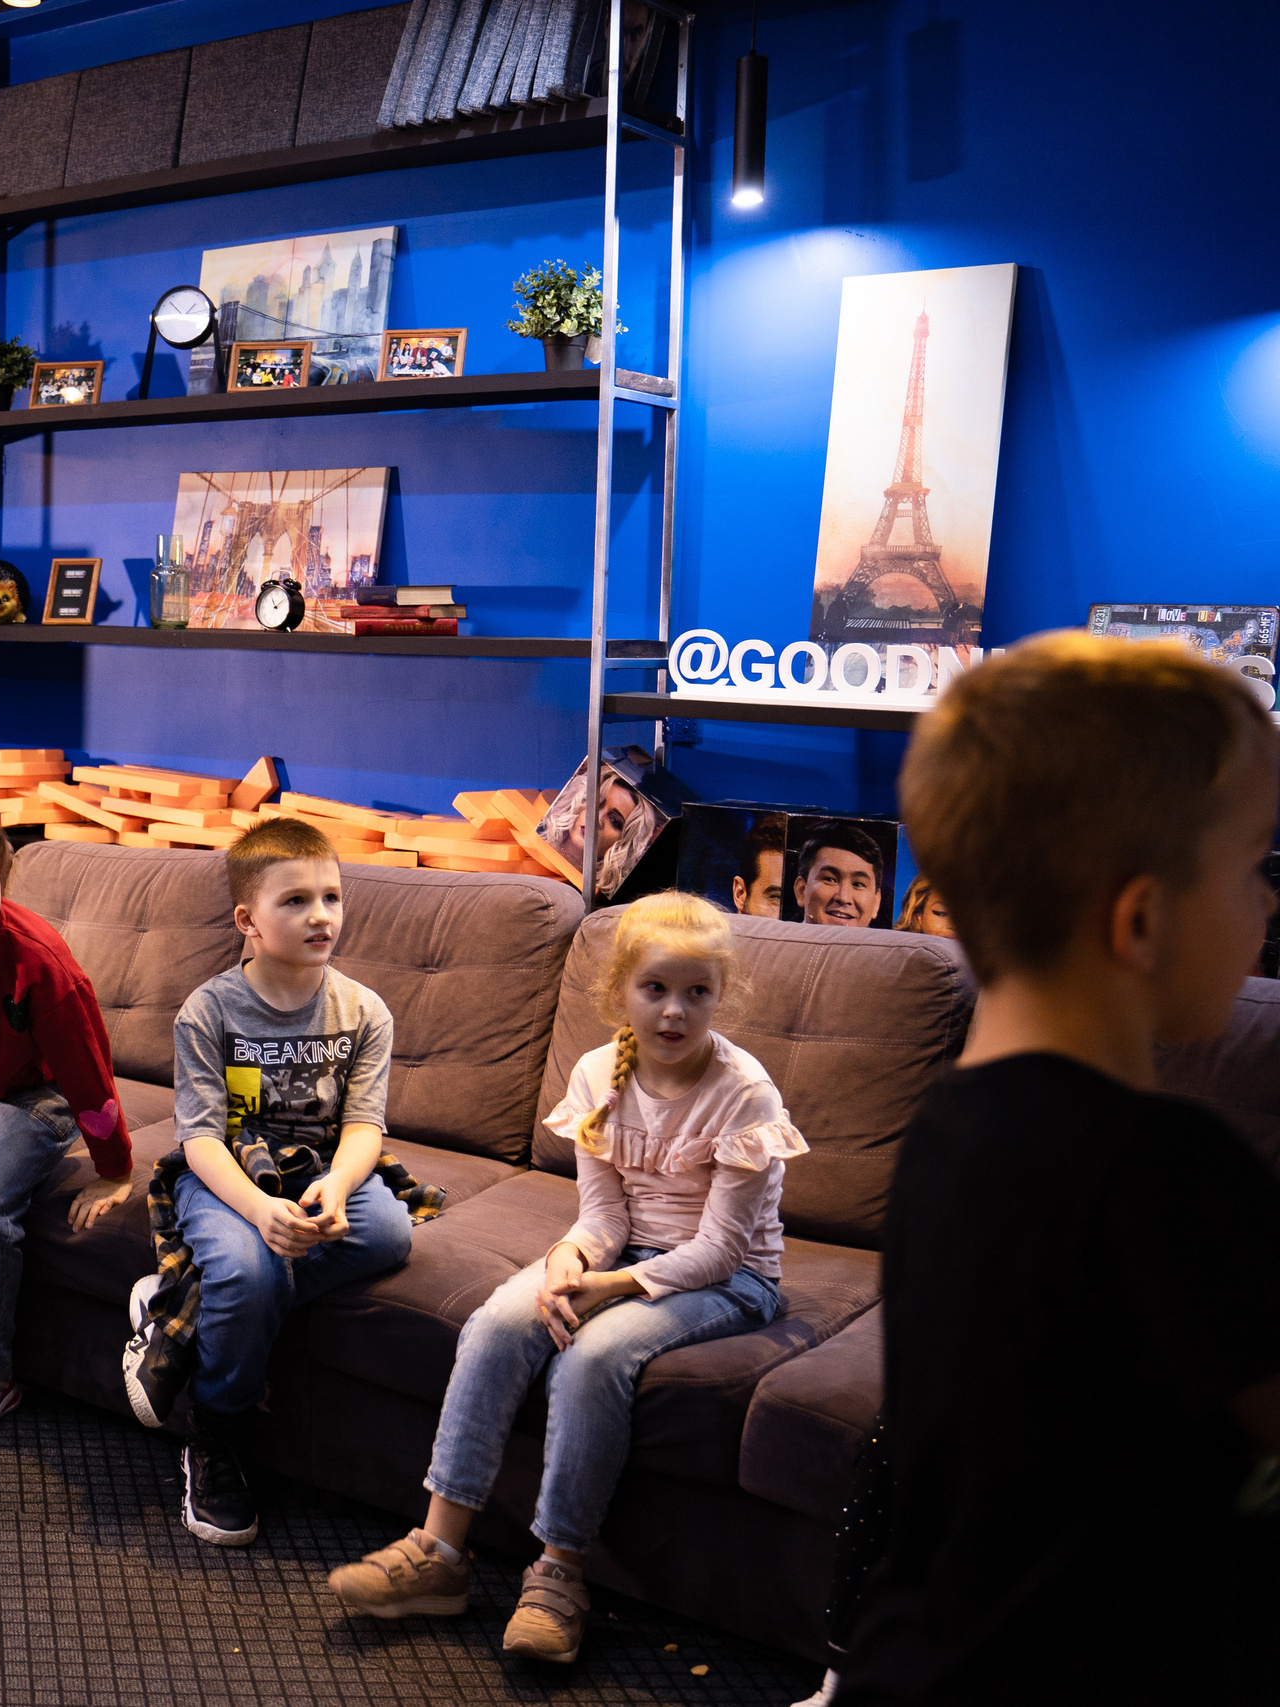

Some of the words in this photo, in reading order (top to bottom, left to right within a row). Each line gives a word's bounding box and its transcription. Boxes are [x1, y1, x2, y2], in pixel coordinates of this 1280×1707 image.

[1143, 609, 1148, 620] I
[1158, 609, 1186, 621] LOVE
[1198, 611, 1222, 622] USA
[234, 1036, 352, 1065] BREAKING
